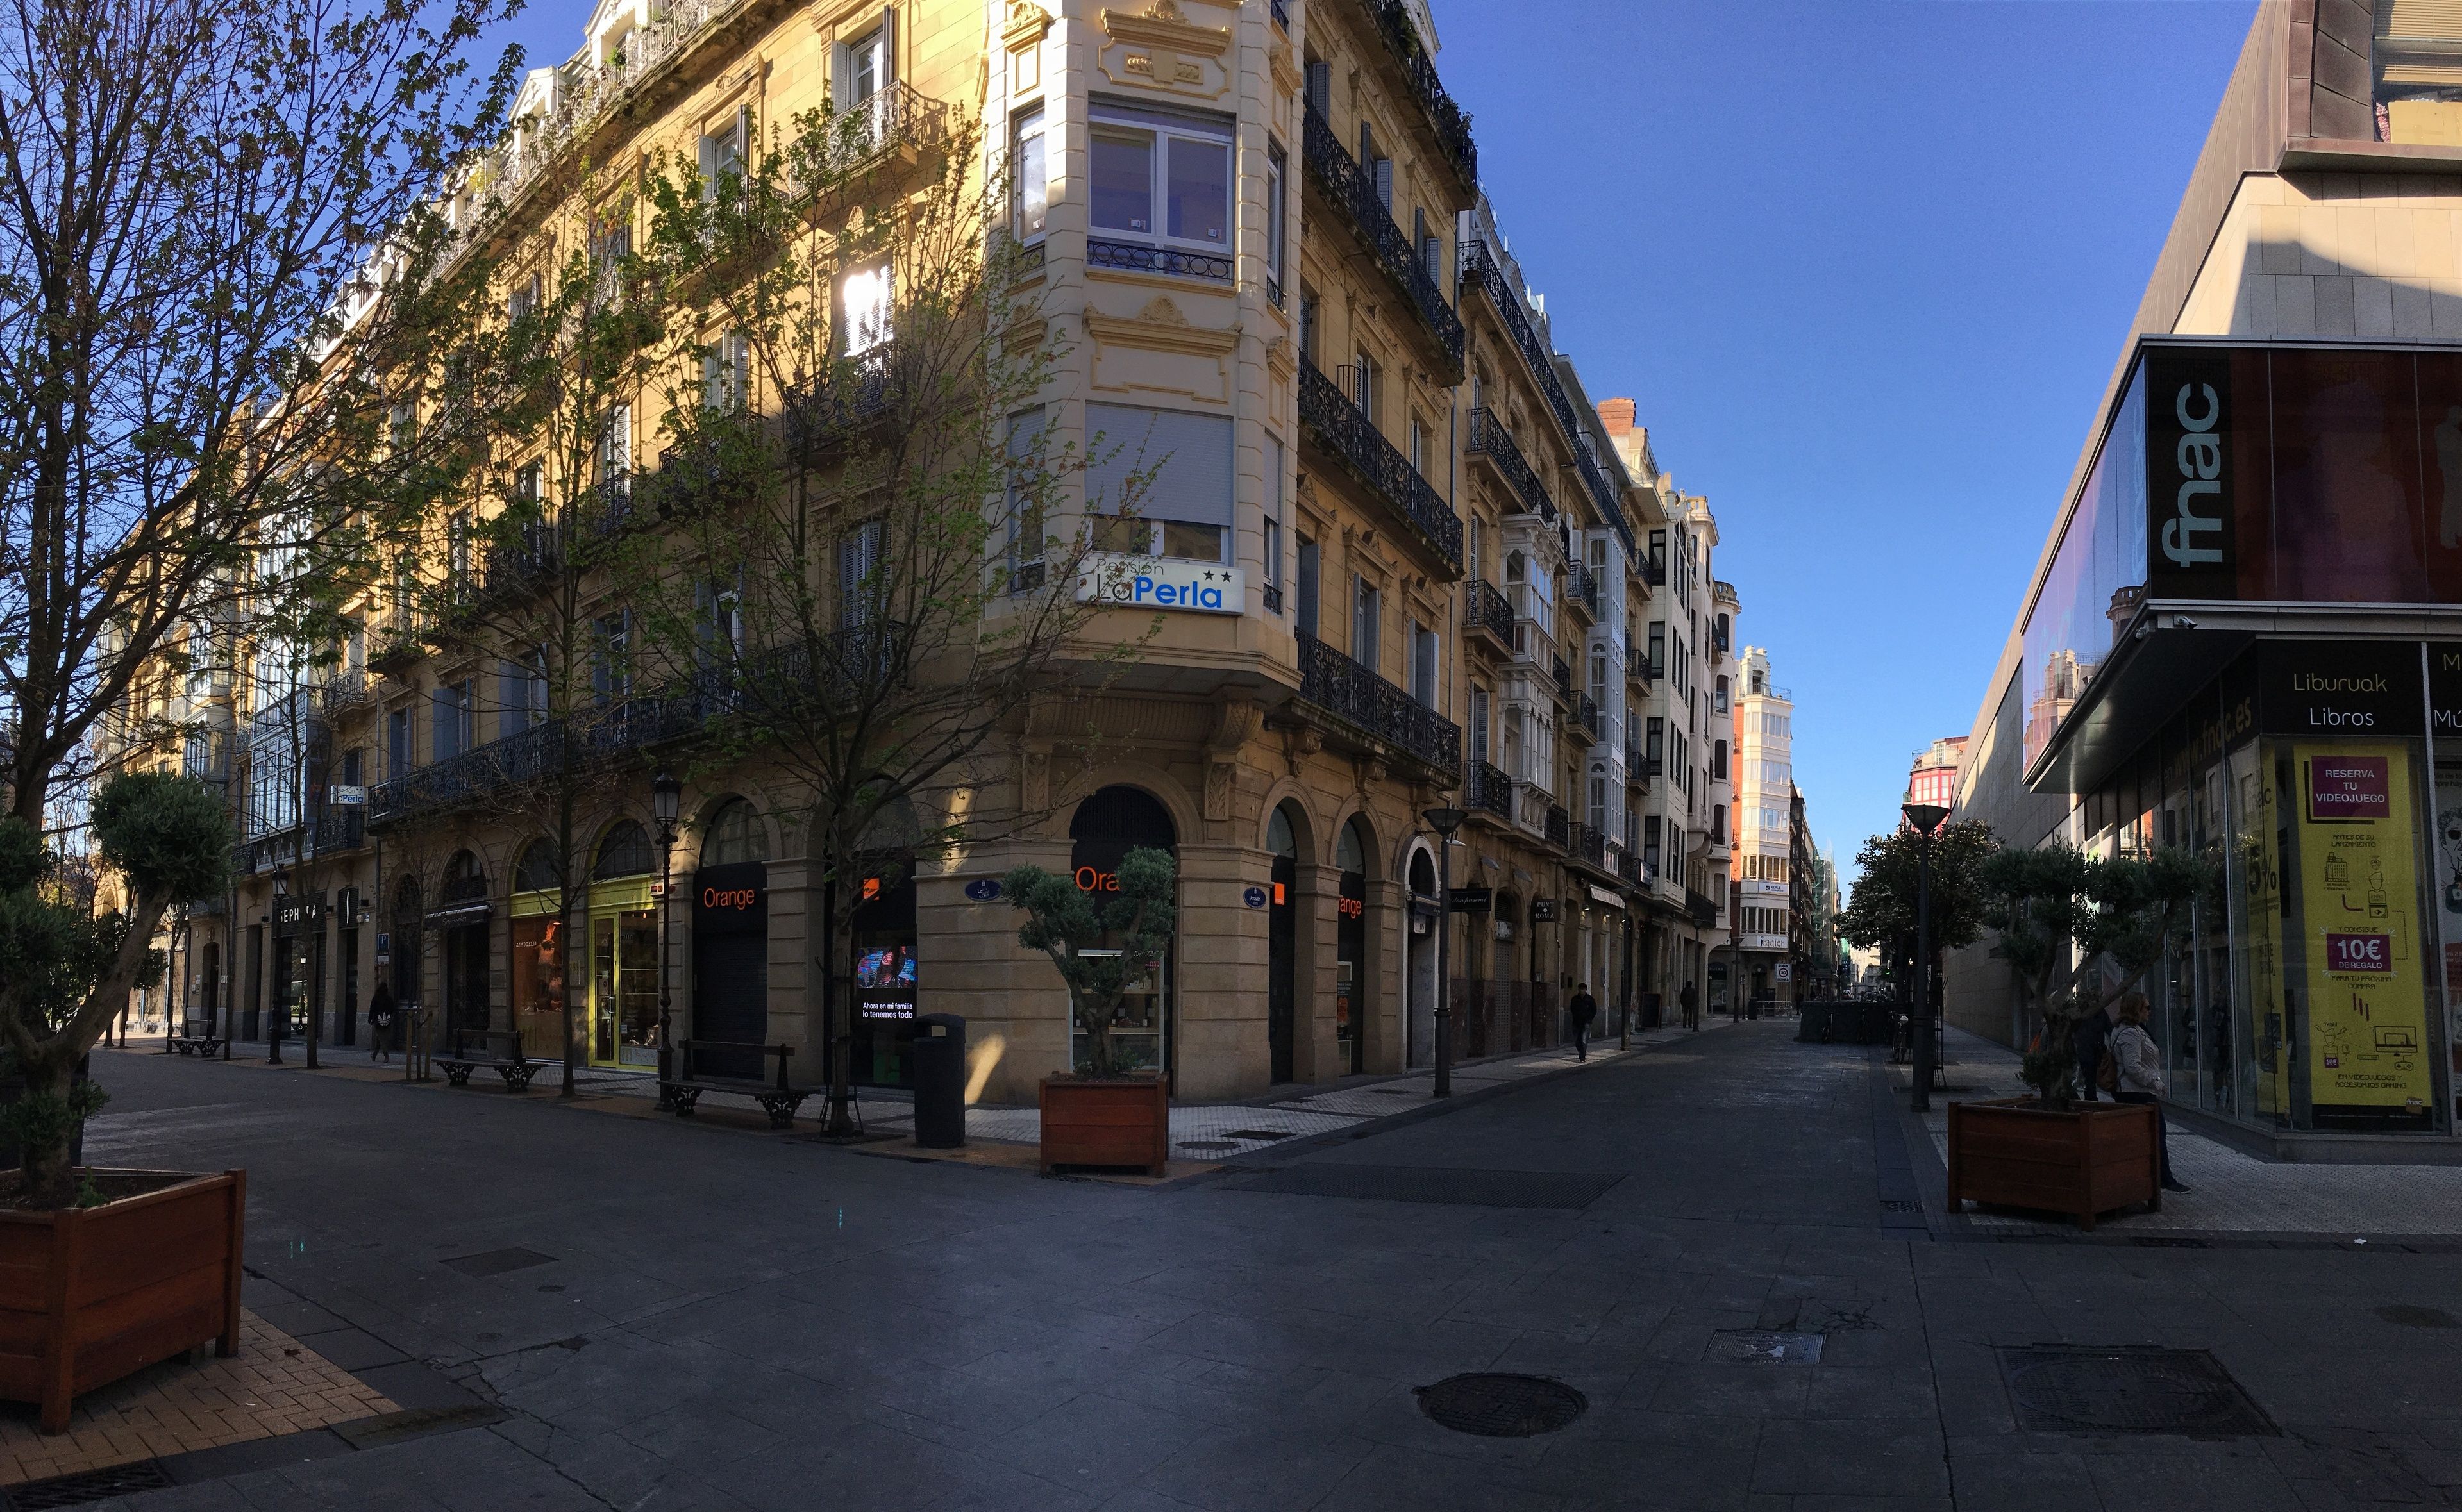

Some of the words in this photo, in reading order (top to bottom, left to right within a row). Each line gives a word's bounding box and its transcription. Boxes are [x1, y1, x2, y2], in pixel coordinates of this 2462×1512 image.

[2161, 383, 2223, 567] fnac
[1097, 573, 1221, 608] LaPerla
[2293, 673, 2388, 692] Liburuak
[2310, 707, 2374, 726] Libros
[2325, 769, 2375, 778] RESERVA
[2343, 782, 2357, 790] TU
[2316, 793, 2385, 802] VIDEOJUEGO
[1076, 865, 1120, 892] Ora
[704, 887, 755, 911] Orange
[1339, 897, 1362, 919] ange
[2337, 939, 2381, 960] 10€
